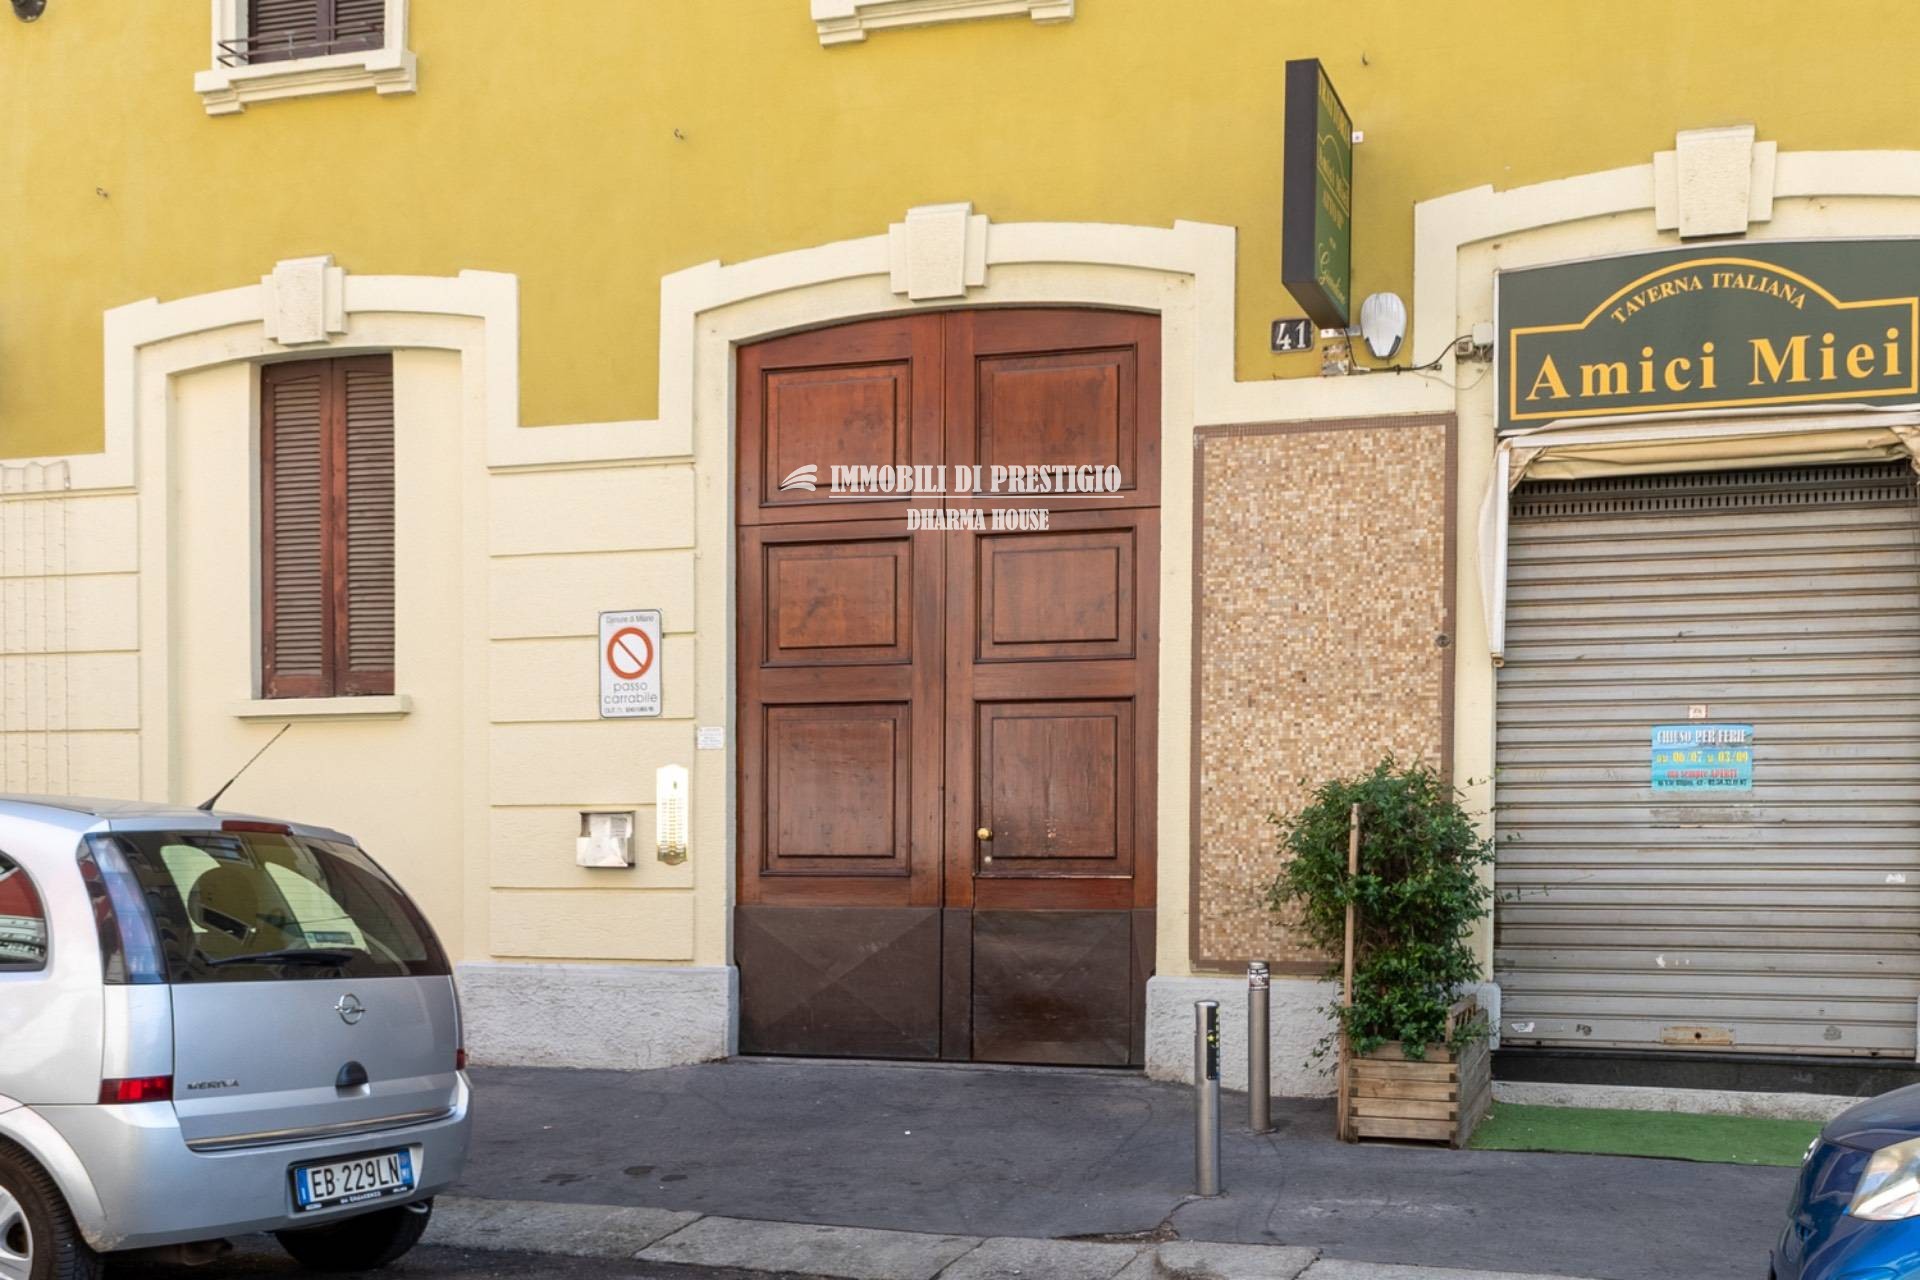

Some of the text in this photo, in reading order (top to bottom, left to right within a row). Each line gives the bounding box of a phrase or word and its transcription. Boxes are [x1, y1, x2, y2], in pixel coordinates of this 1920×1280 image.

[1610, 272, 1806, 325] TAVERNA ITALIANA
[1275, 320, 1307, 350] 41
[1525, 327, 1902, 401] Amici Miei
[603, 692, 658, 704] carrabile
[613, 682, 648, 694] passo
